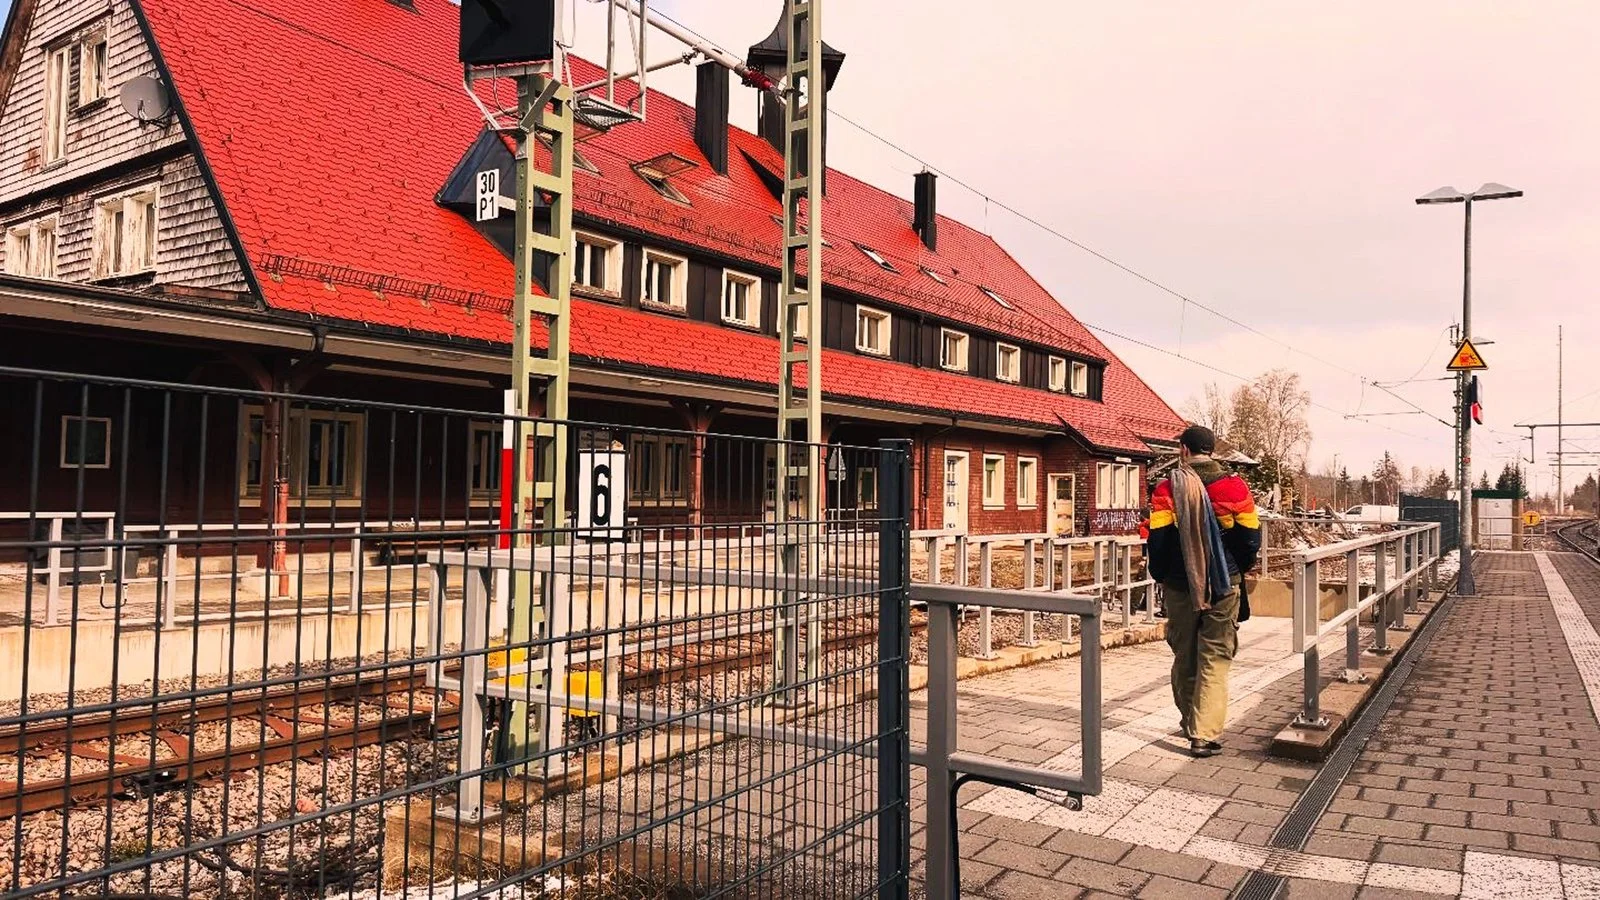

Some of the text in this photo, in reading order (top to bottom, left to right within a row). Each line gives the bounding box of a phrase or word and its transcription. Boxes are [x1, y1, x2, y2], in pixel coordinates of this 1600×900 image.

[480, 172, 495, 195] 30
[480, 196, 494, 219] P1
[593, 464, 611, 526] 6
